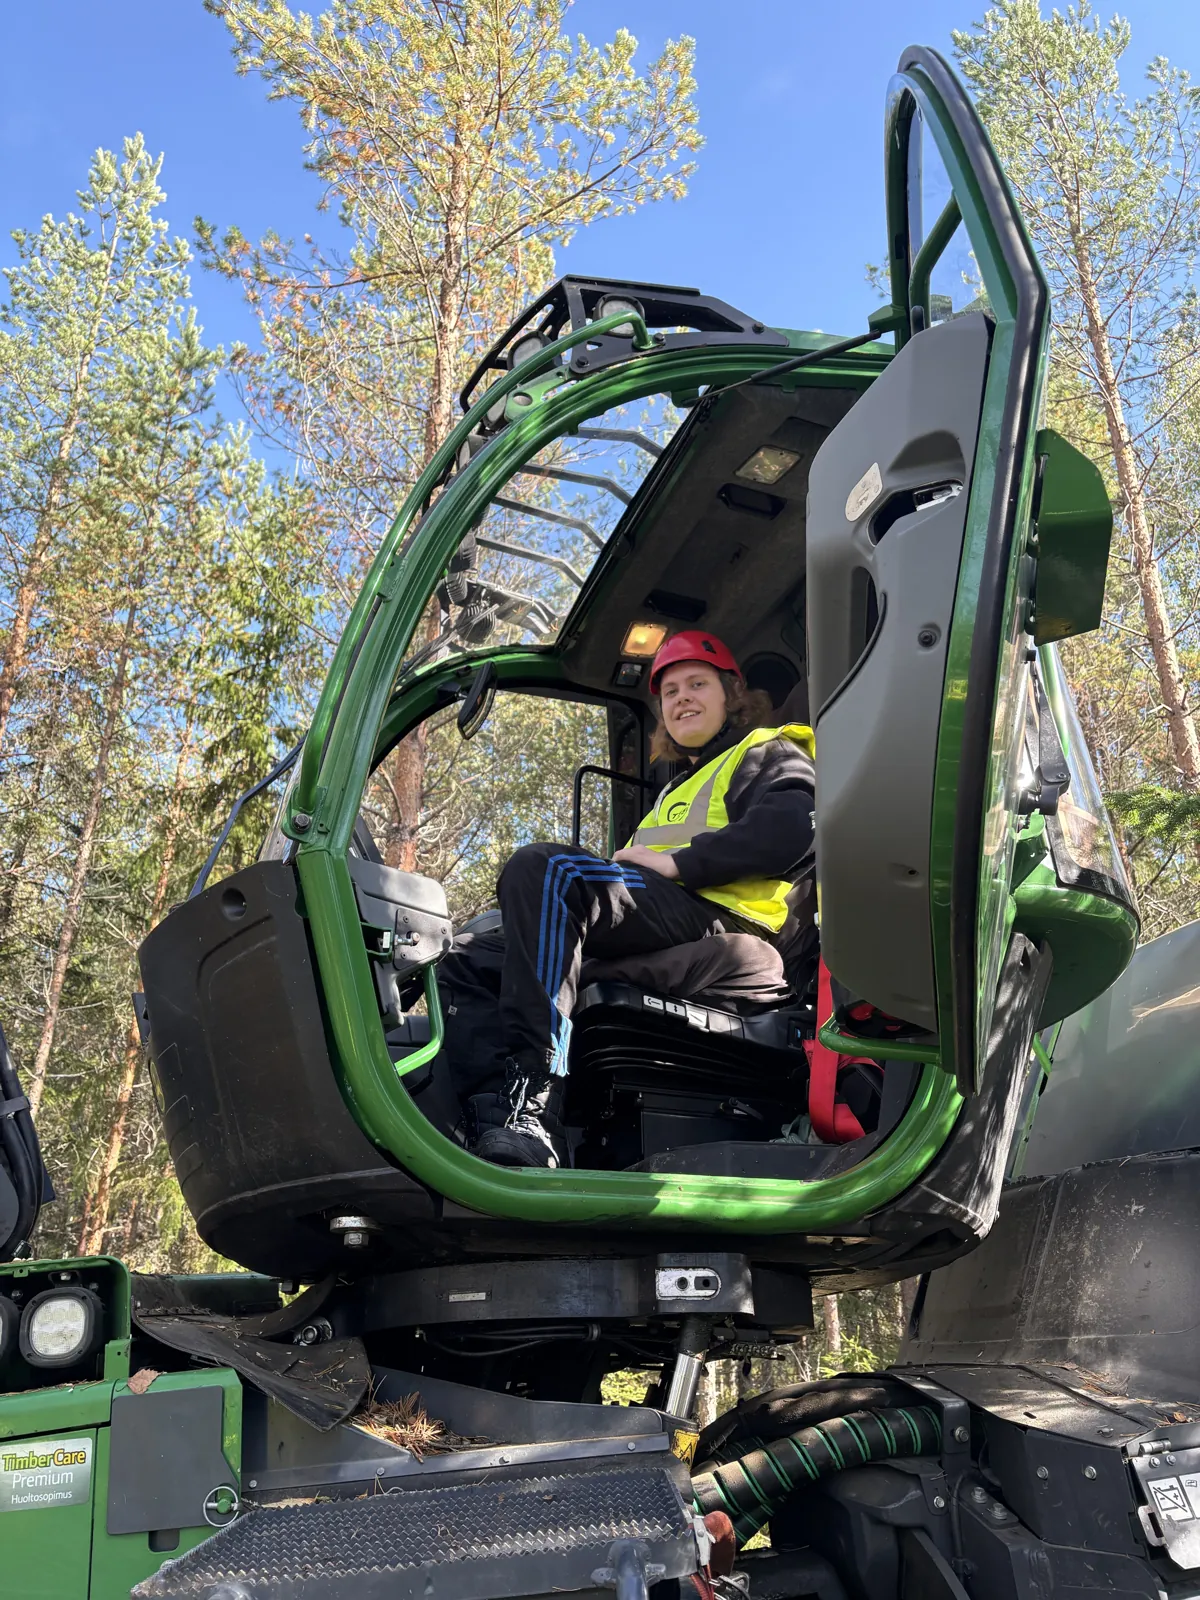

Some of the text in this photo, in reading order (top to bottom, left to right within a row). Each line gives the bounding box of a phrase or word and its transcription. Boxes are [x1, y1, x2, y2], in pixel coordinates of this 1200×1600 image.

[2, 1448, 86, 1471] TimberCare
[12, 1470, 73, 1489] Premium
[11, 1491, 72, 1504] Huoltosopimus
